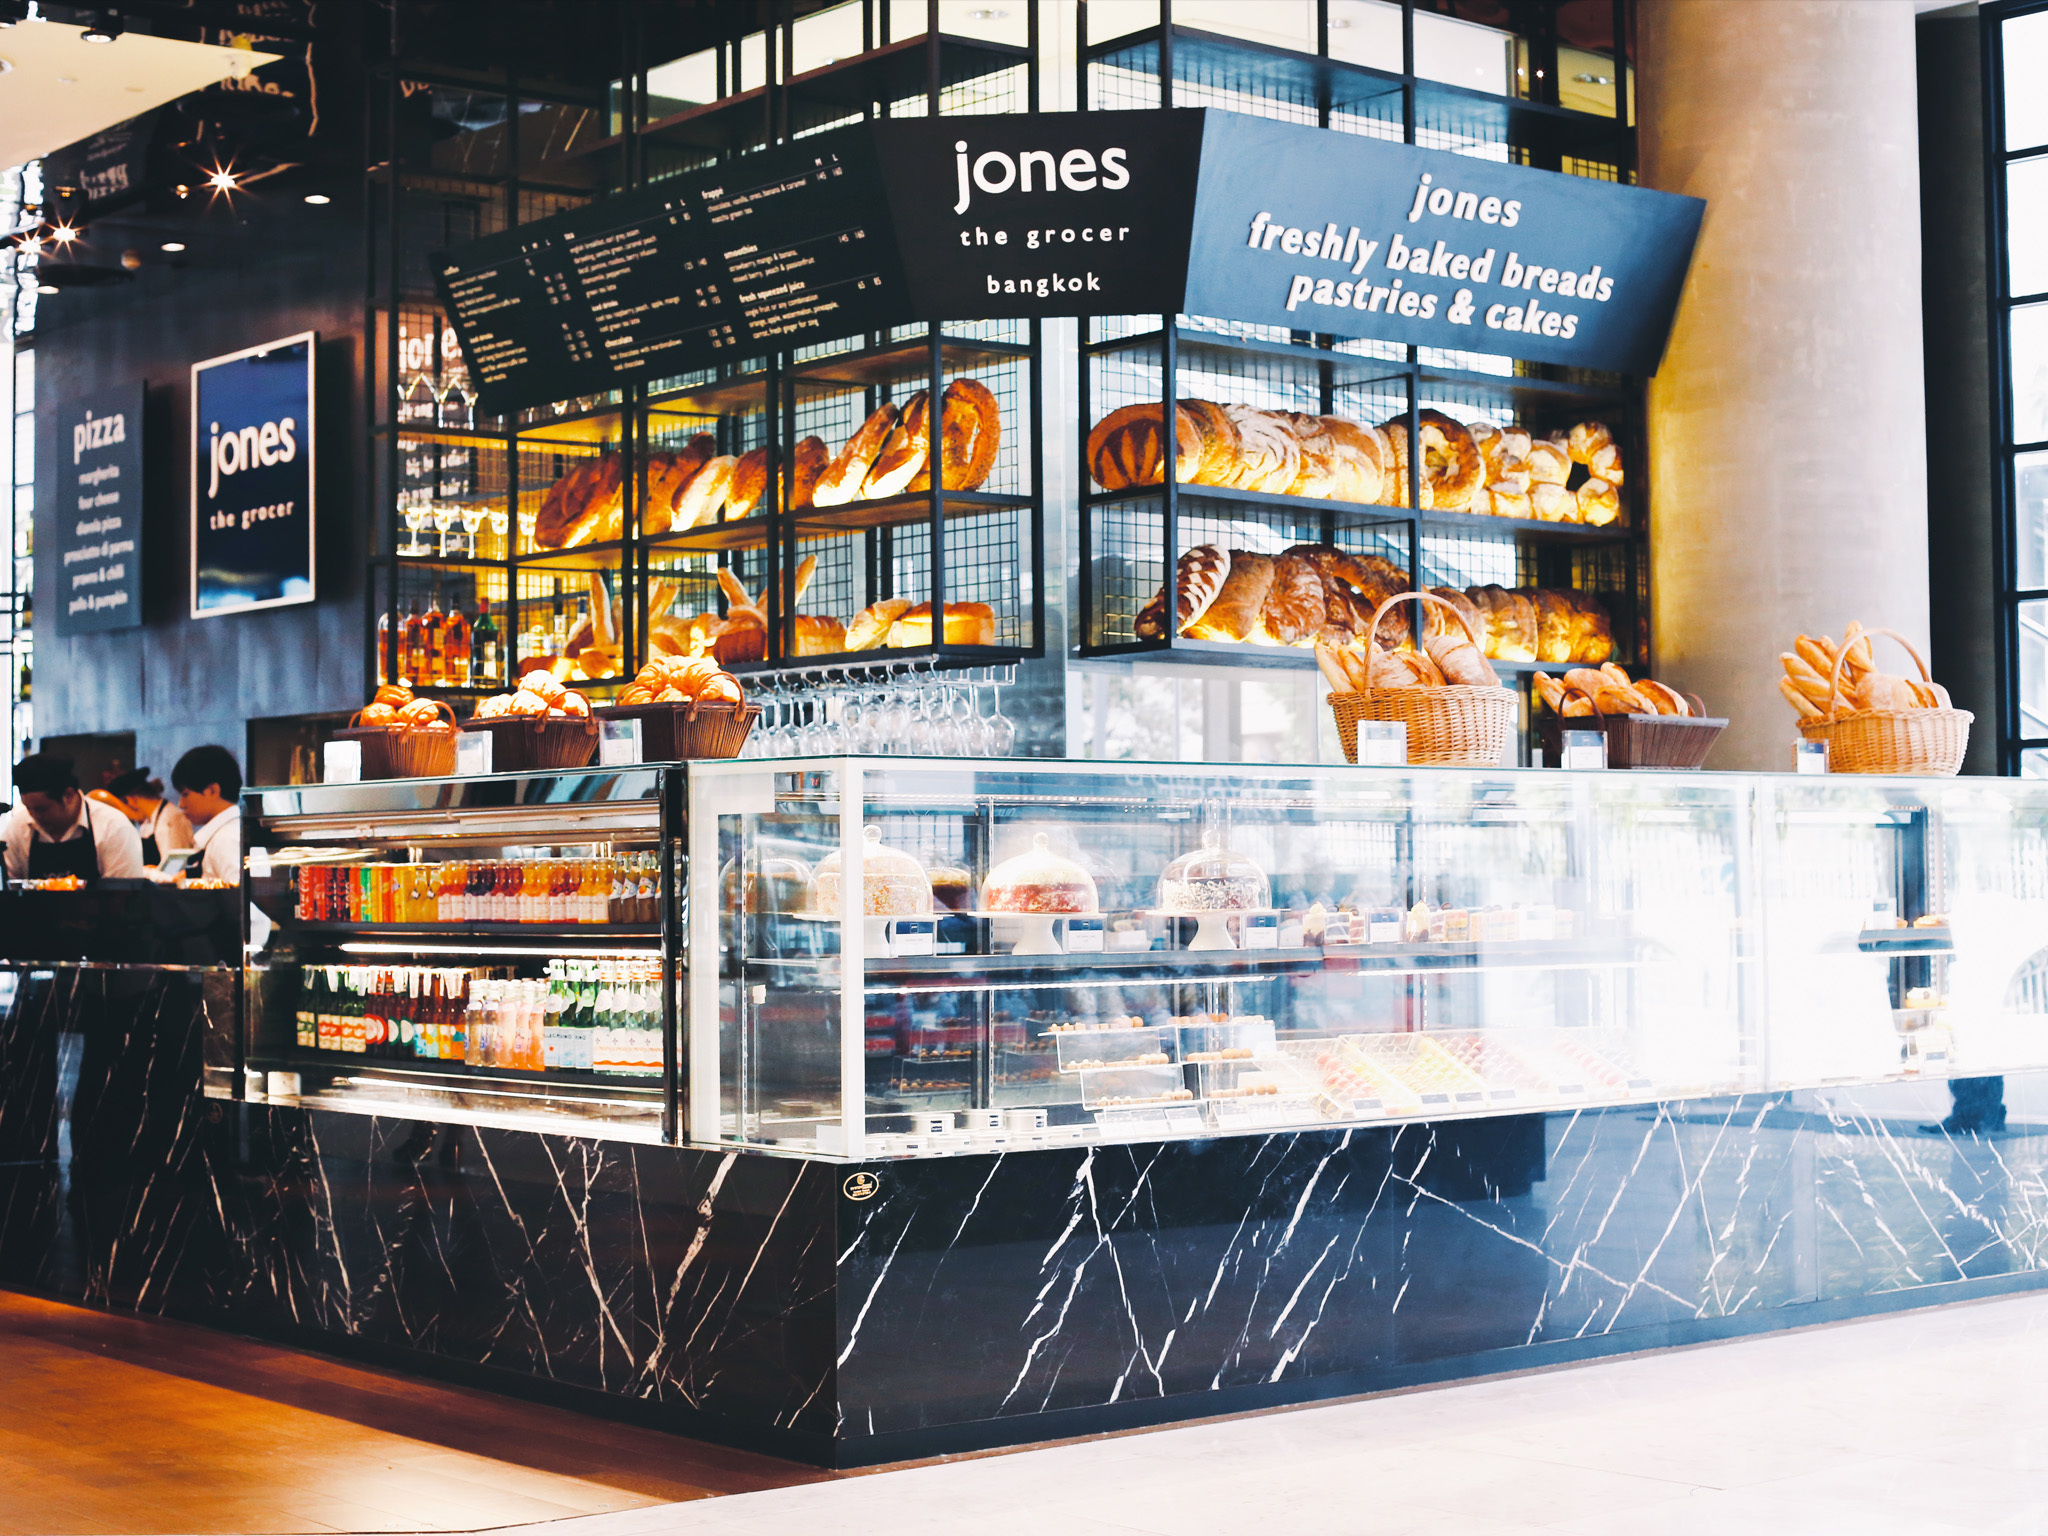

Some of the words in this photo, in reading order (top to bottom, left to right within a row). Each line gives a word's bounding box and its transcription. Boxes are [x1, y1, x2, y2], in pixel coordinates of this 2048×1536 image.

[952, 140, 1130, 216] jones
[1408, 172, 1523, 228] jones
[959, 225, 1009, 248] the
[1026, 223, 1131, 250] grocer
[1247, 212, 1378, 276] freshly
[1385, 225, 1493, 286] baked
[1499, 255, 1616, 305] breads
[739, 292, 757, 303] fresh
[757, 284, 789, 300] squeezed
[788, 282, 806, 294] juice
[986, 271, 1102, 299] bangkok
[1285, 267, 1440, 323] pastries
[1446, 290, 1475, 327] &
[1484, 297, 1580, 341] cakes
[74, 410, 125, 464] pizza
[208, 417, 296, 499] jones
[210, 508, 236, 531] the
[241, 500, 295, 531] grocer
